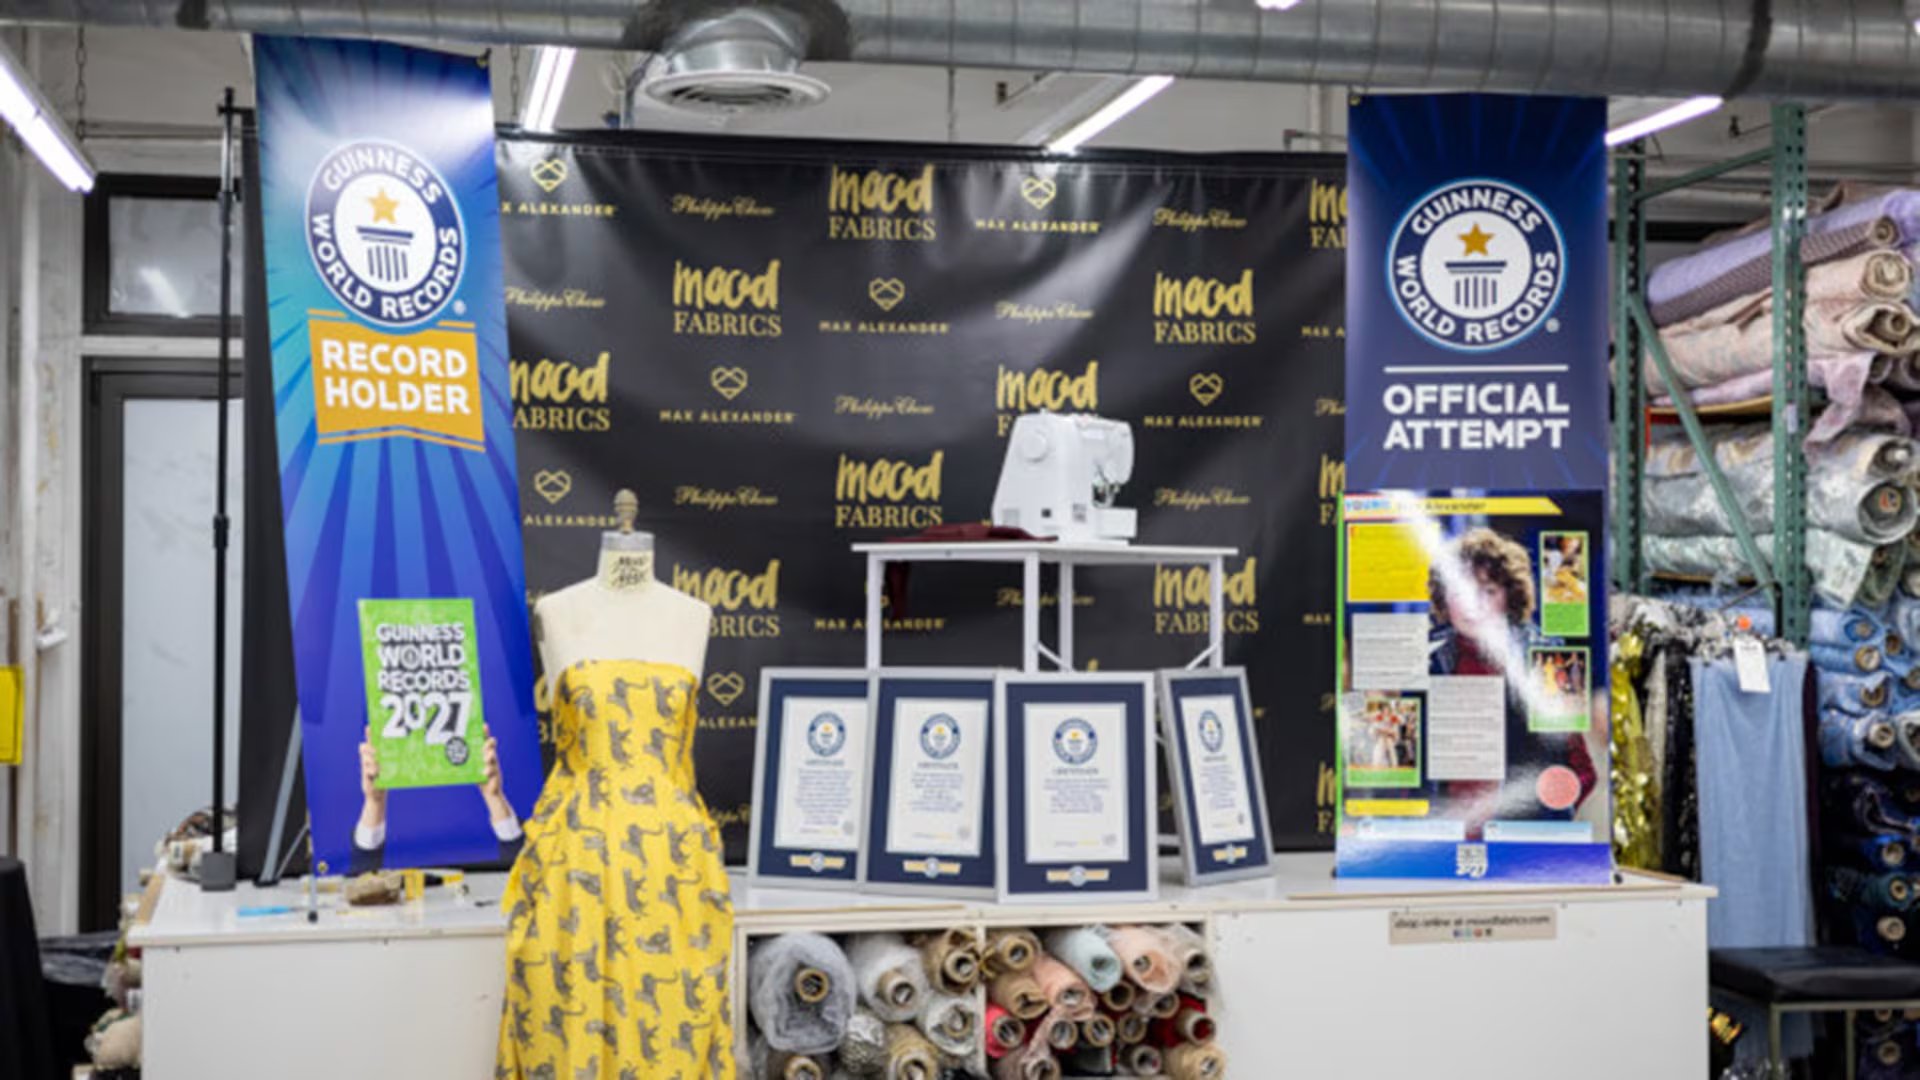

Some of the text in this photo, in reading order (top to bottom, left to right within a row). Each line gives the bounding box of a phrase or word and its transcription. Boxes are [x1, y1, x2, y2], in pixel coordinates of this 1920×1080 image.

[323, 147, 442, 204] GUINNESS
[828, 163, 935, 214] mood
[518, 202, 615, 217] ALEXANDER
[1411, 188, 1543, 235] GUINNESS
[828, 215, 937, 241] FABRICS
[975, 219, 1099, 234] MAX ALEXANDER
[312, 214, 459, 320] WORLD RECORDS
[673, 259, 781, 310] mood
[1153, 268, 1253, 320] mood
[1397, 252, 1556, 342] WORLD RECORDS
[673, 311, 782, 336] FABRICS
[819, 321, 949, 335] MAX ALEXANDER
[1154, 321, 1257, 344] FABRICS
[321, 339, 469, 378] RECORD
[324, 376, 472, 415] HOLDER
[996, 360, 1099, 413] mood
[1383, 383, 1570, 414] OFFICIAL
[512, 406, 611, 432] ABRICS
[659, 410, 795, 424] MAX ALEXANDER
[1143, 416, 1263, 428] MAX ALEXANDER
[1383, 419, 1570, 450] ATTEMPT
[836, 450, 945, 504] mood
[835, 505, 944, 528] FABRICS
[376, 623, 465, 643] GUINNESS
[711, 615, 781, 637] BRICS
[815, 618, 945, 631] MAX AXANDER
[1155, 611, 1260, 634] FABCS
[377, 643, 467, 669] WORLD
[377, 669, 470, 693] RECORDS
[380, 692, 473, 745] 2027
[699, 716, 758, 729] ALEXAN
